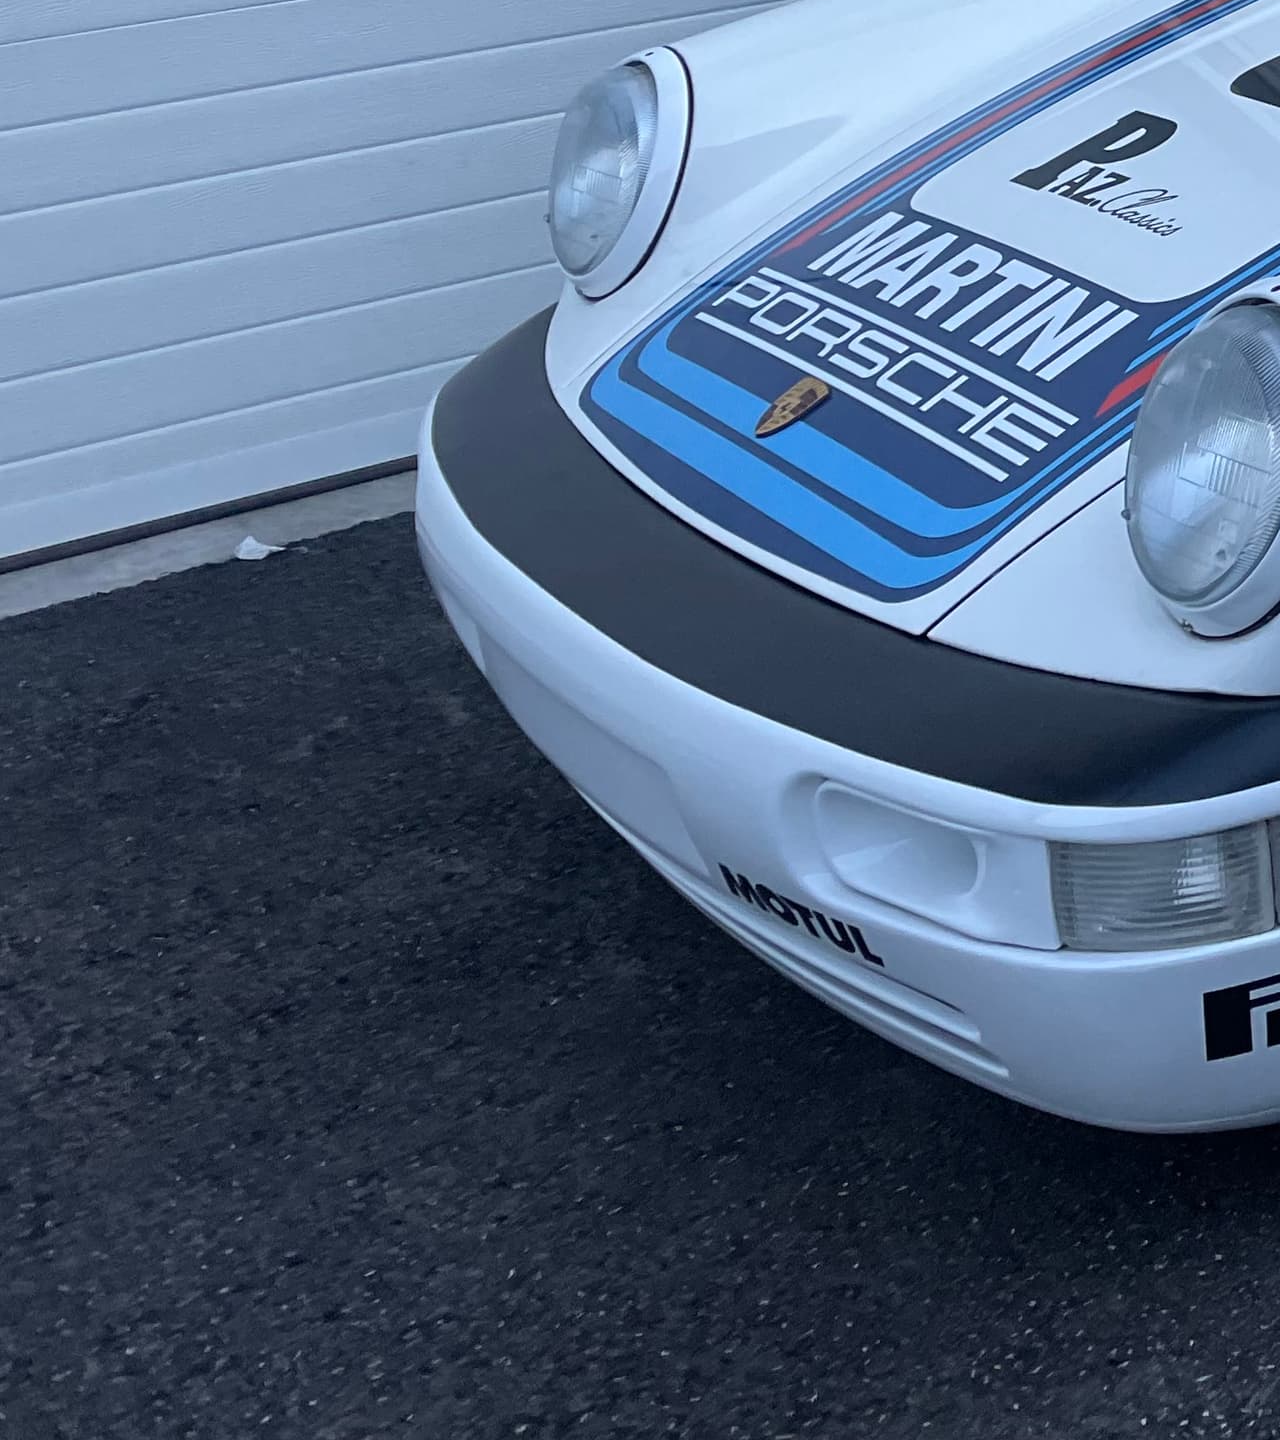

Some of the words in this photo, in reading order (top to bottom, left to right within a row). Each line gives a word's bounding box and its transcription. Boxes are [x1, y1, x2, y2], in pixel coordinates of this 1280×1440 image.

[1098, 188, 1183, 237] Classics
[807, 211, 1139, 382] MARTINI
[712, 275, 1066, 466] PORSCHE
[718, 862, 885, 967] MOTUL
